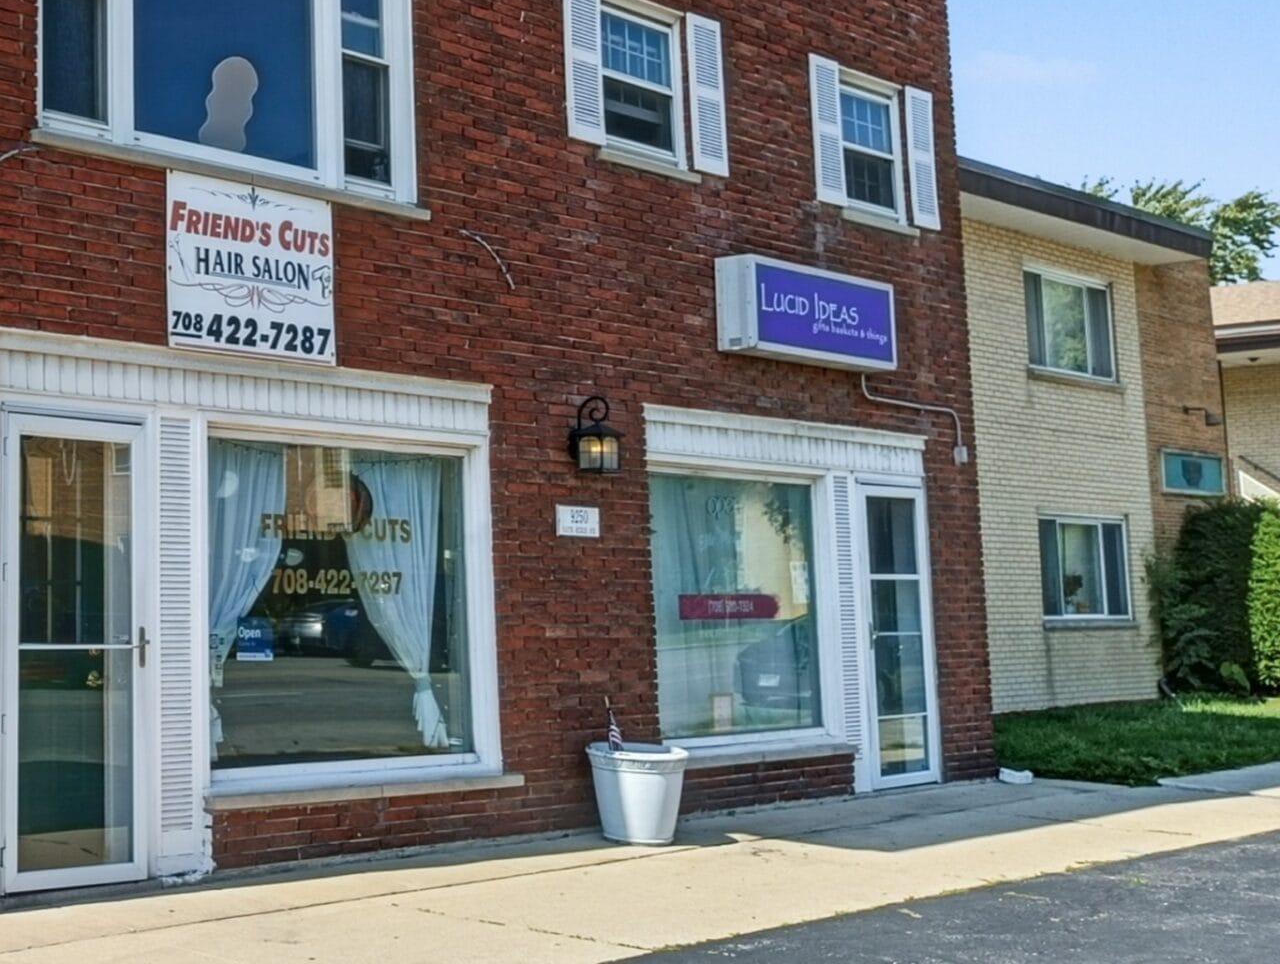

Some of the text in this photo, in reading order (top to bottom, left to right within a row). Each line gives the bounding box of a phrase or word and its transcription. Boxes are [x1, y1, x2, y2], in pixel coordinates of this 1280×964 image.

[195, 246, 310, 290] HAIR SALON
[171, 310, 331, 356] 708 422-7287
[361, 518, 412, 544] CUTS
[238, 626, 261, 641] Open
